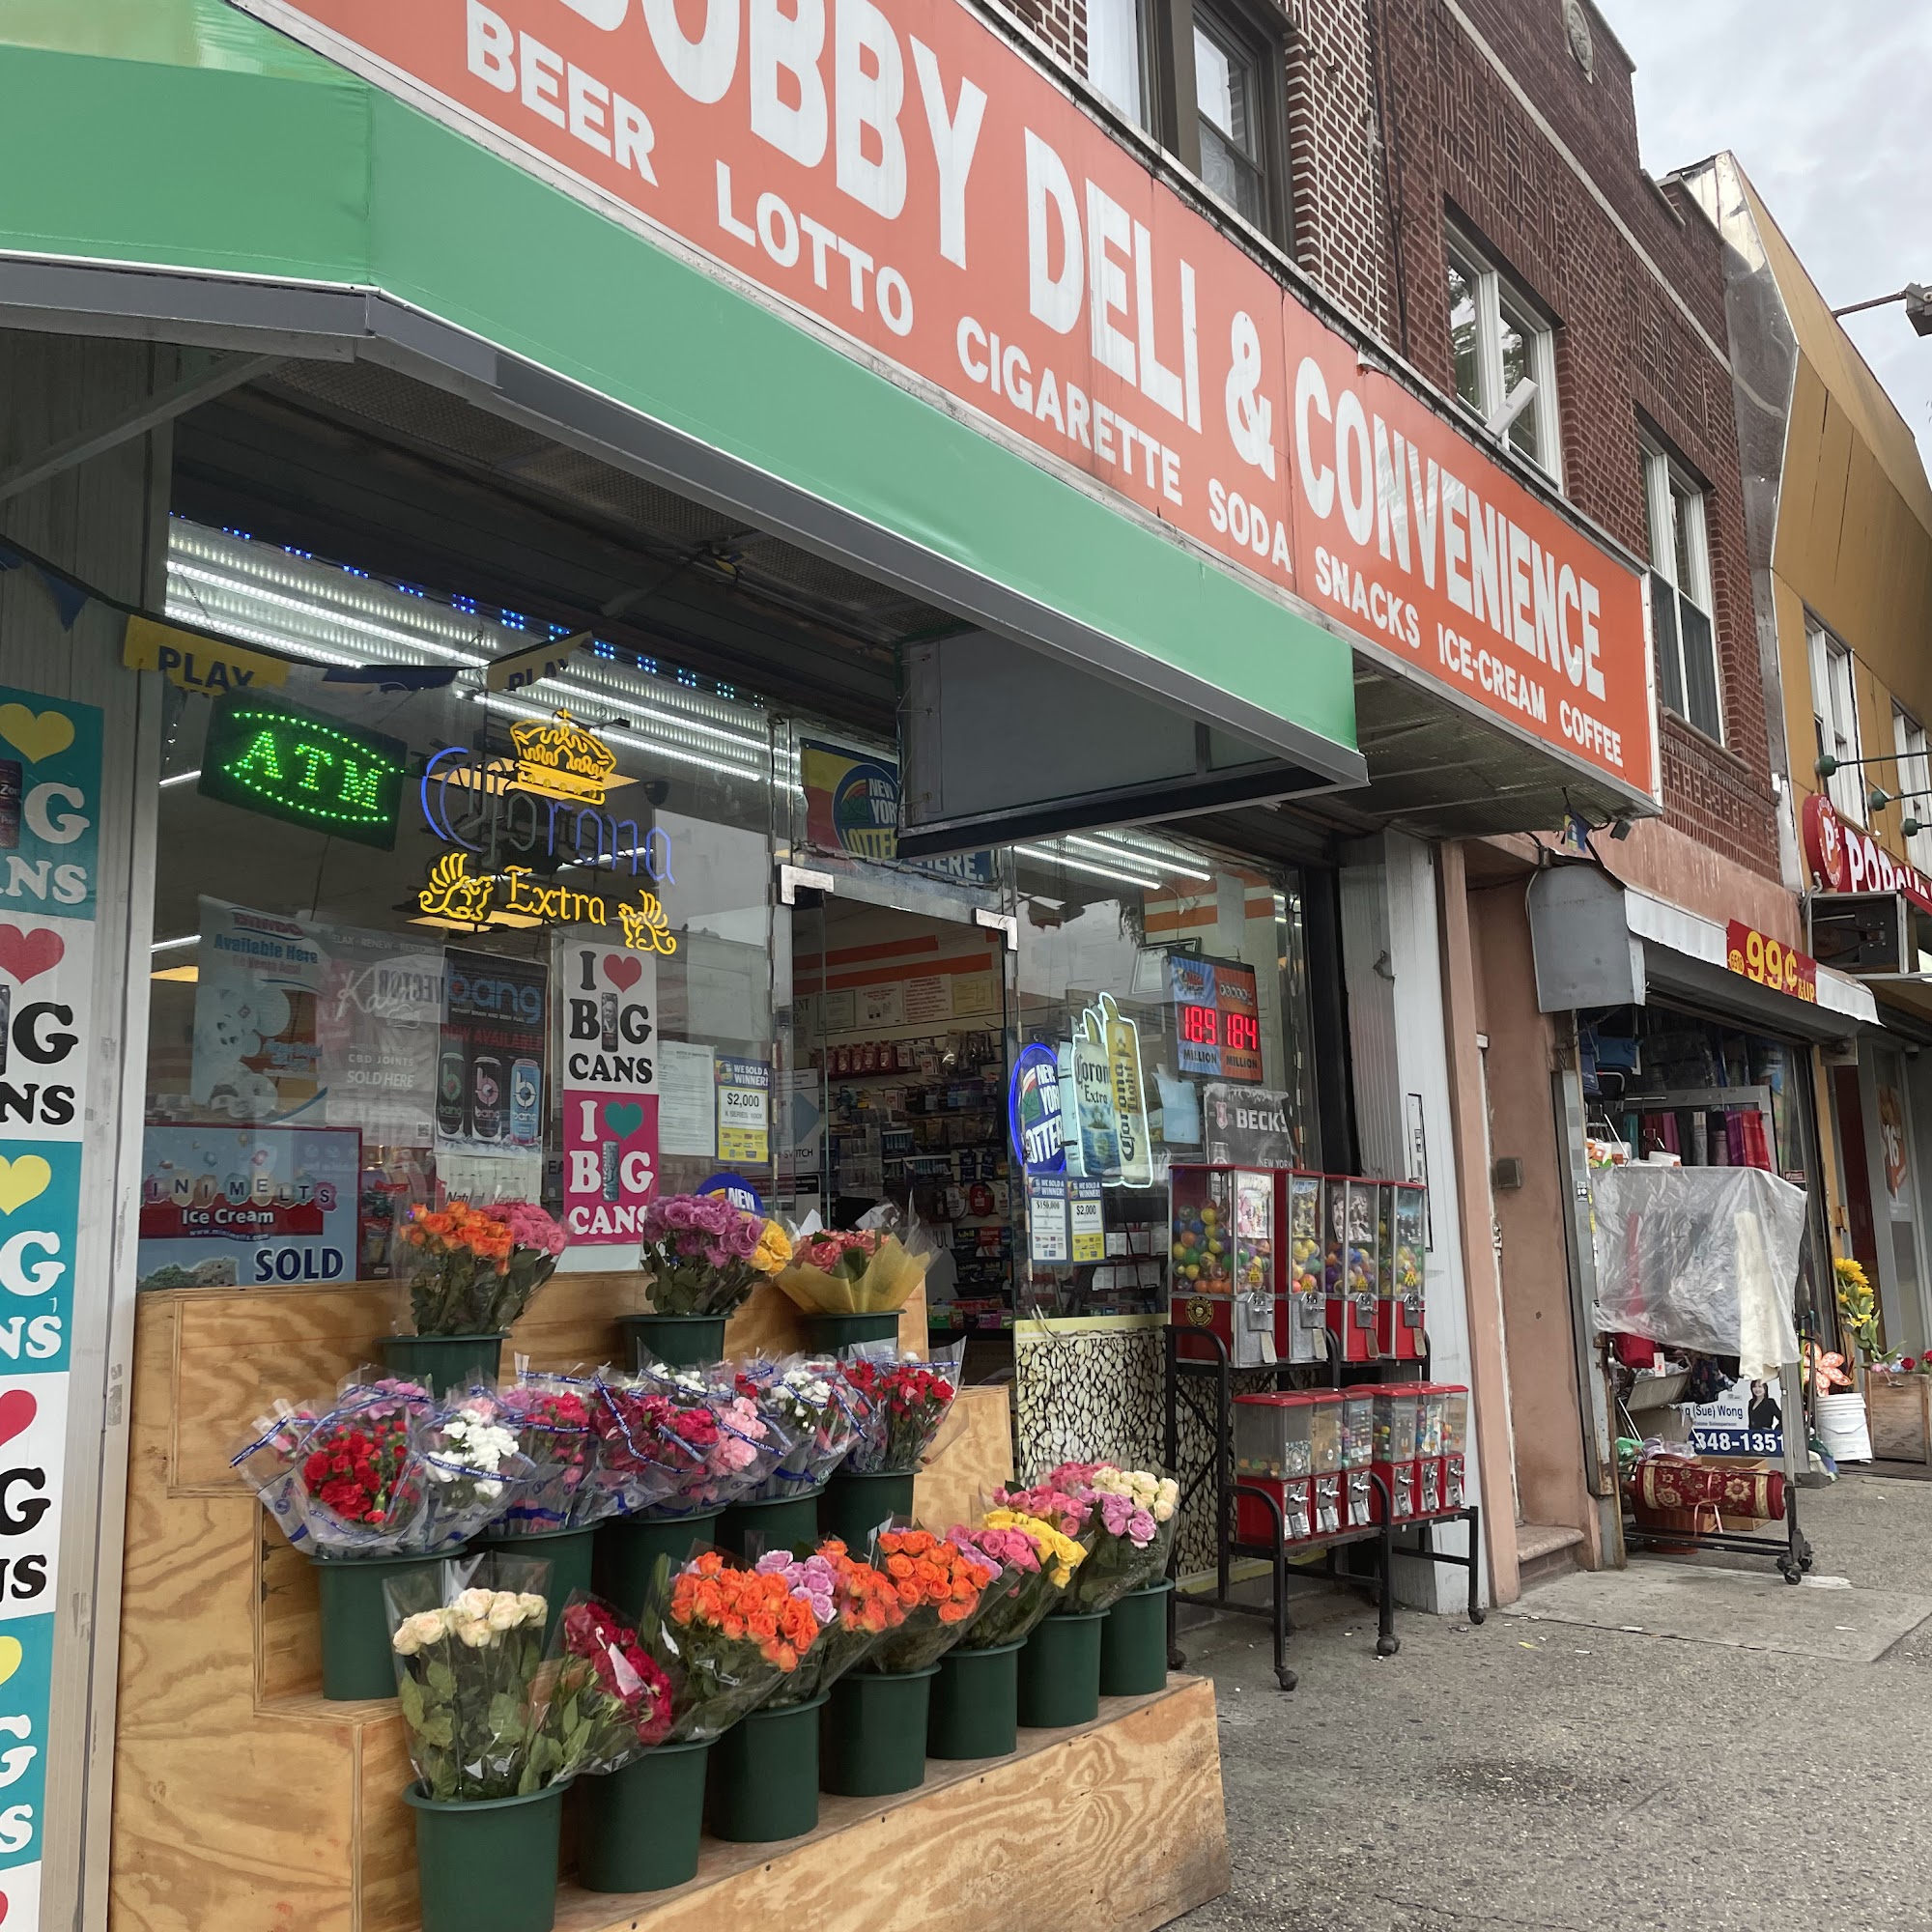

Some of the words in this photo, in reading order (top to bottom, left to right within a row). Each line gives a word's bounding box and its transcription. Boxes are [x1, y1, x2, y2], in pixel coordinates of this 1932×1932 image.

[559, 0, 987, 270] BBY
[1024, 126, 1202, 435] DELI
[1225, 311, 1275, 481] &
[1295, 356, 1606, 701] CONVENIENCE
[466, 0, 659, 187] BEER
[716, 159, 914, 336] LOTTO
[956, 316, 1182, 506] CIGARETTE
[1208, 478, 1293, 574] SODA
[1315, 546, 1421, 649] SNACKS
[1437, 622, 1548, 724] ICE-CREAM
[1559, 700, 1623, 768] COFFEE
[157, 645, 254, 690] PLAY
[237, 730, 384, 810] ATM
[868, 778, 895, 800] NEW
[420, 746, 675, 885] Corona
[870, 799, 898, 824] YOR
[841, 828, 899, 860] LOTTER
[504, 865, 607, 925] Extra
[213, 933, 283, 959] Available
[285, 945, 319, 964] Here
[331, 934, 355, 946] ELAX
[579, 951, 597, 991] I
[447, 963, 542, 1025] bang
[1184, 1006, 1217, 1046] 189
[1226, 1012, 1257, 1050] 184
[348, 1054, 373, 1064] CBD
[377, 1056, 413, 1066] JOINTS
[568, 1053, 653, 1085] CANS
[733, 1064, 745, 1073] WE
[745, 1065, 762, 1075] SOLD
[762, 1067, 769, 1076] A
[1075, 1053, 1111, 1085] Coron
[1182, 1048, 1217, 1065] MILLION
[1225, 1055, 1258, 1069] MILLION
[347, 1069, 382, 1085] SOLD
[384, 1072, 414, 1088] HERE
[733, 1073, 769, 1087] WINNER!
[726, 1092, 760, 1108] $2,000
[1039, 1085, 1061, 1116] YOR
[1081, 1084, 1108, 1105] Extra
[579, 1100, 598, 1142] I
[1236, 1107, 1289, 1133] BECK'S
[1022, 1115, 1064, 1164] OTTER
[229, 1178, 330, 1204] MELTS
[726, 1186, 756, 1211] NEW
[182, 1209, 210, 1225] Ice
[214, 1208, 274, 1225] Cream
[568, 1205, 647, 1236] CANS
[1076, 1205, 1096, 1215] $2,000
[254, 1247, 344, 1283] SOLD
[1692, 1405, 1716, 1419] (Sue)
[1717, 1405, 1744, 1420] Wong
